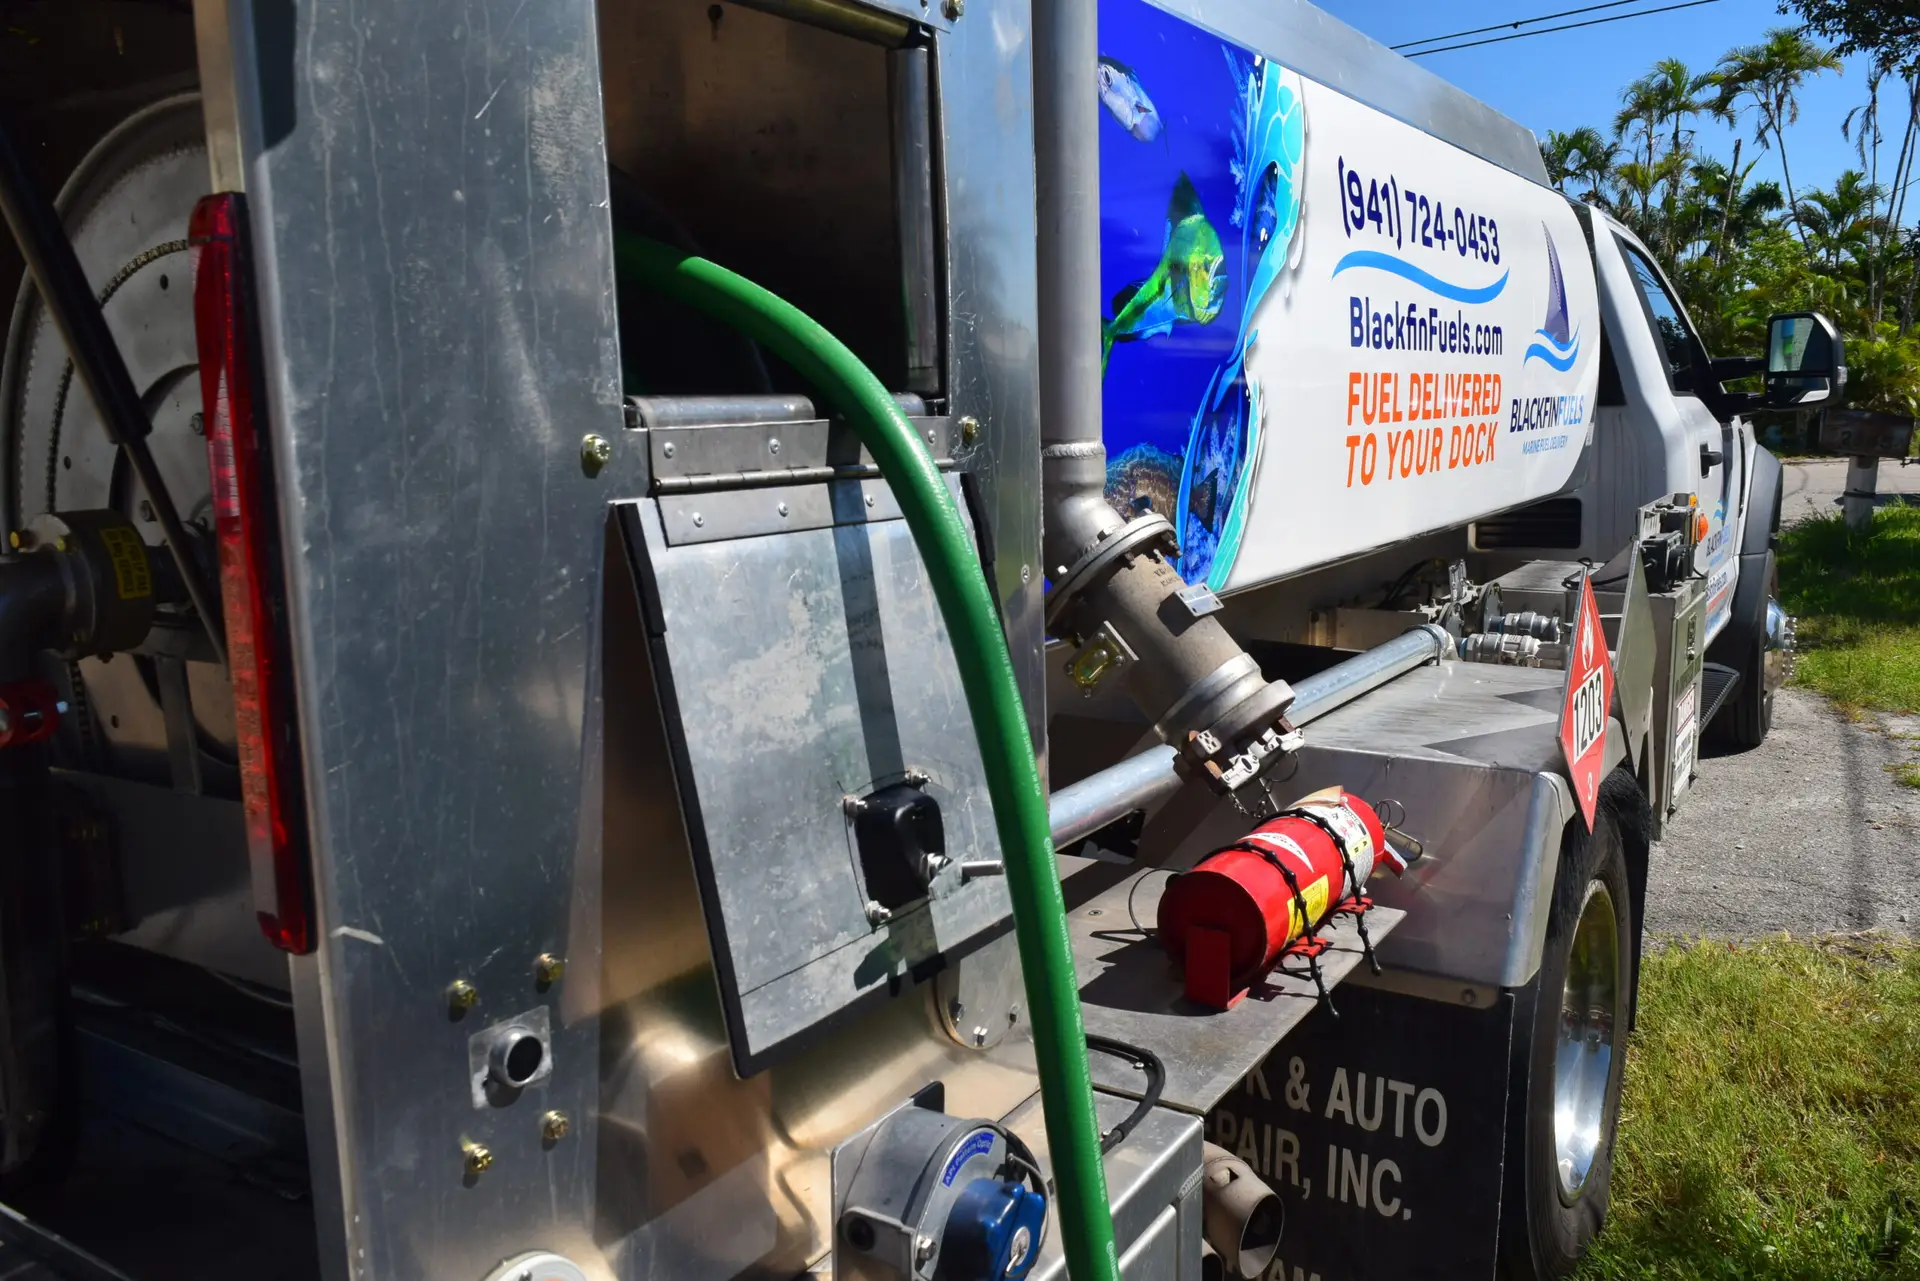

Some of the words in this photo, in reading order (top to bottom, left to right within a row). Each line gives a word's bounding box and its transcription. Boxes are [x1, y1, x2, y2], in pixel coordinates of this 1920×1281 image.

[1338, 155, 1401, 250] (941)
[1405, 190, 1500, 265] 724-0453
[1350, 296, 1503, 356] BlackfinFuels.com
[1347, 372, 1403, 426] FUEL
[1408, 372, 1501, 421] DELIVERED
[1510, 395, 1584, 433] BLACKFINFUELS
[1346, 432, 1376, 488] TO
[1387, 427, 1443, 480] YOUR
[1448, 422, 1498, 469] DOCK
[1574, 672, 1602, 758] 1203
[1587, 771, 1593, 802] 3
[1285, 1055, 1312, 1113] &
[1325, 1067, 1448, 1147] AUTO
[1205, 1108, 1311, 1200] PAIR,
[1327, 1144, 1412, 1221] INC.
